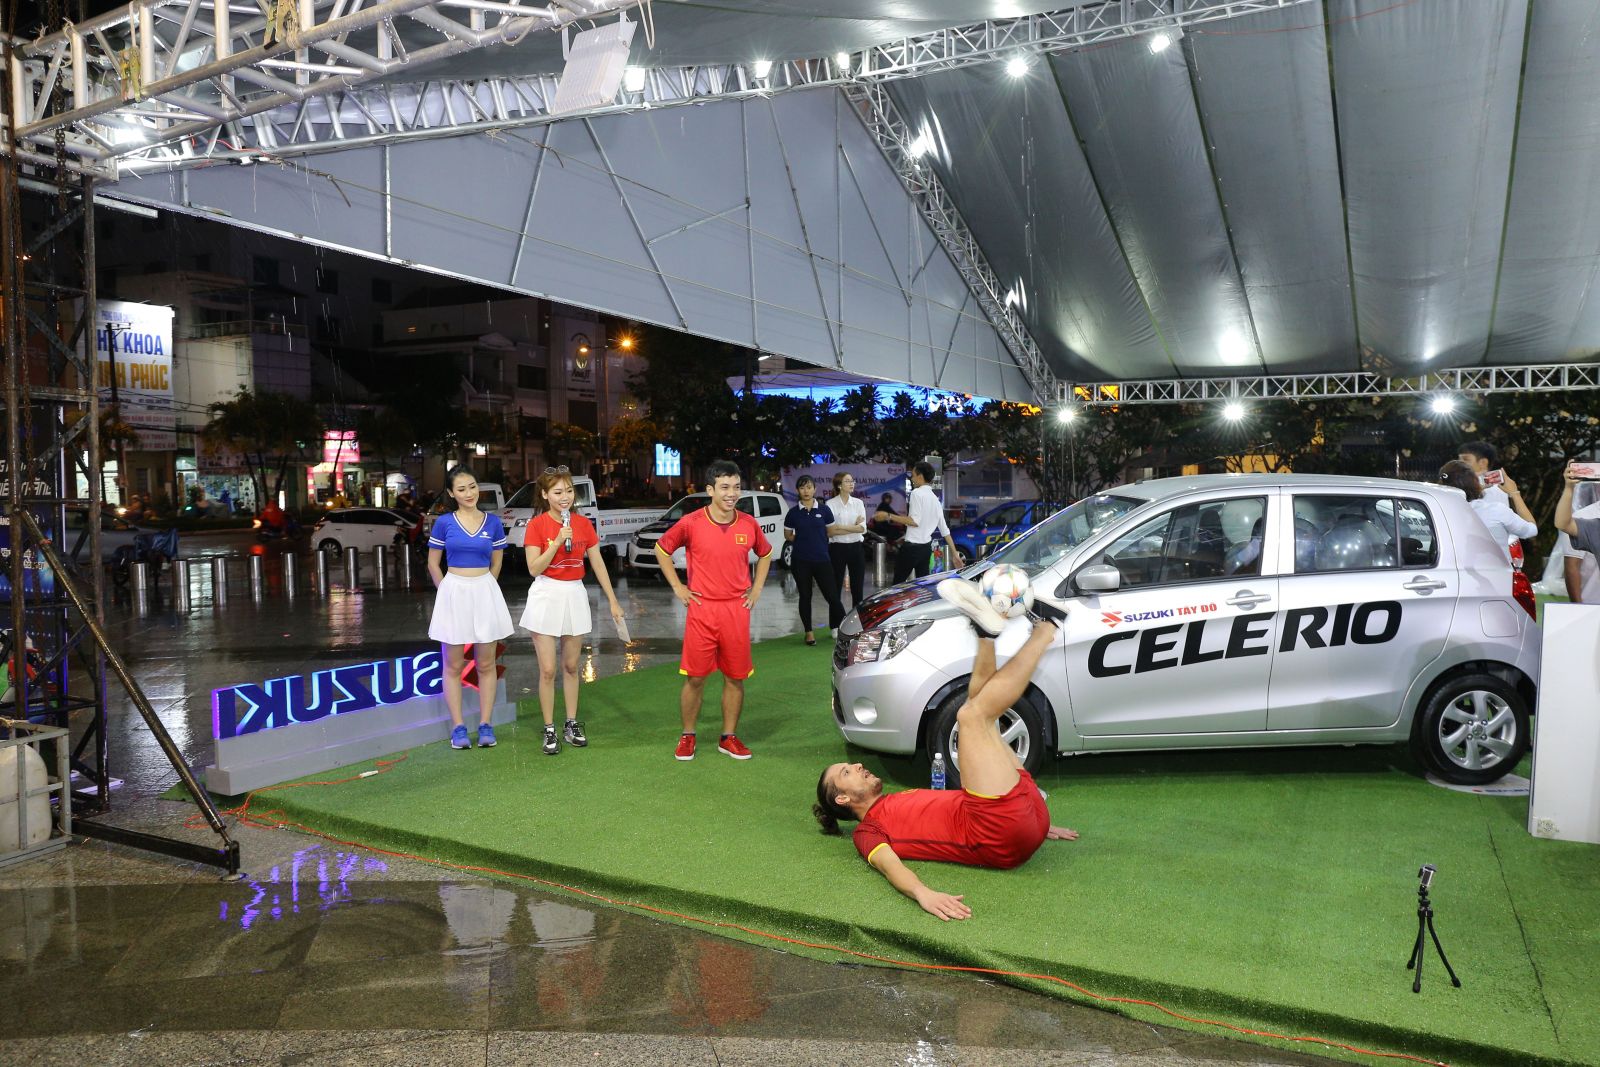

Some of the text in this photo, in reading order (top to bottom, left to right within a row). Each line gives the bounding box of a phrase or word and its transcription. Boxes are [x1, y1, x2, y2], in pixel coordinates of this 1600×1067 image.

[123, 332, 164, 356] KHOA
[130, 360, 169, 391] PHÚC
[1124, 608, 1174, 623] SUZUKI
[1087, 600, 1403, 679] CELERIO
